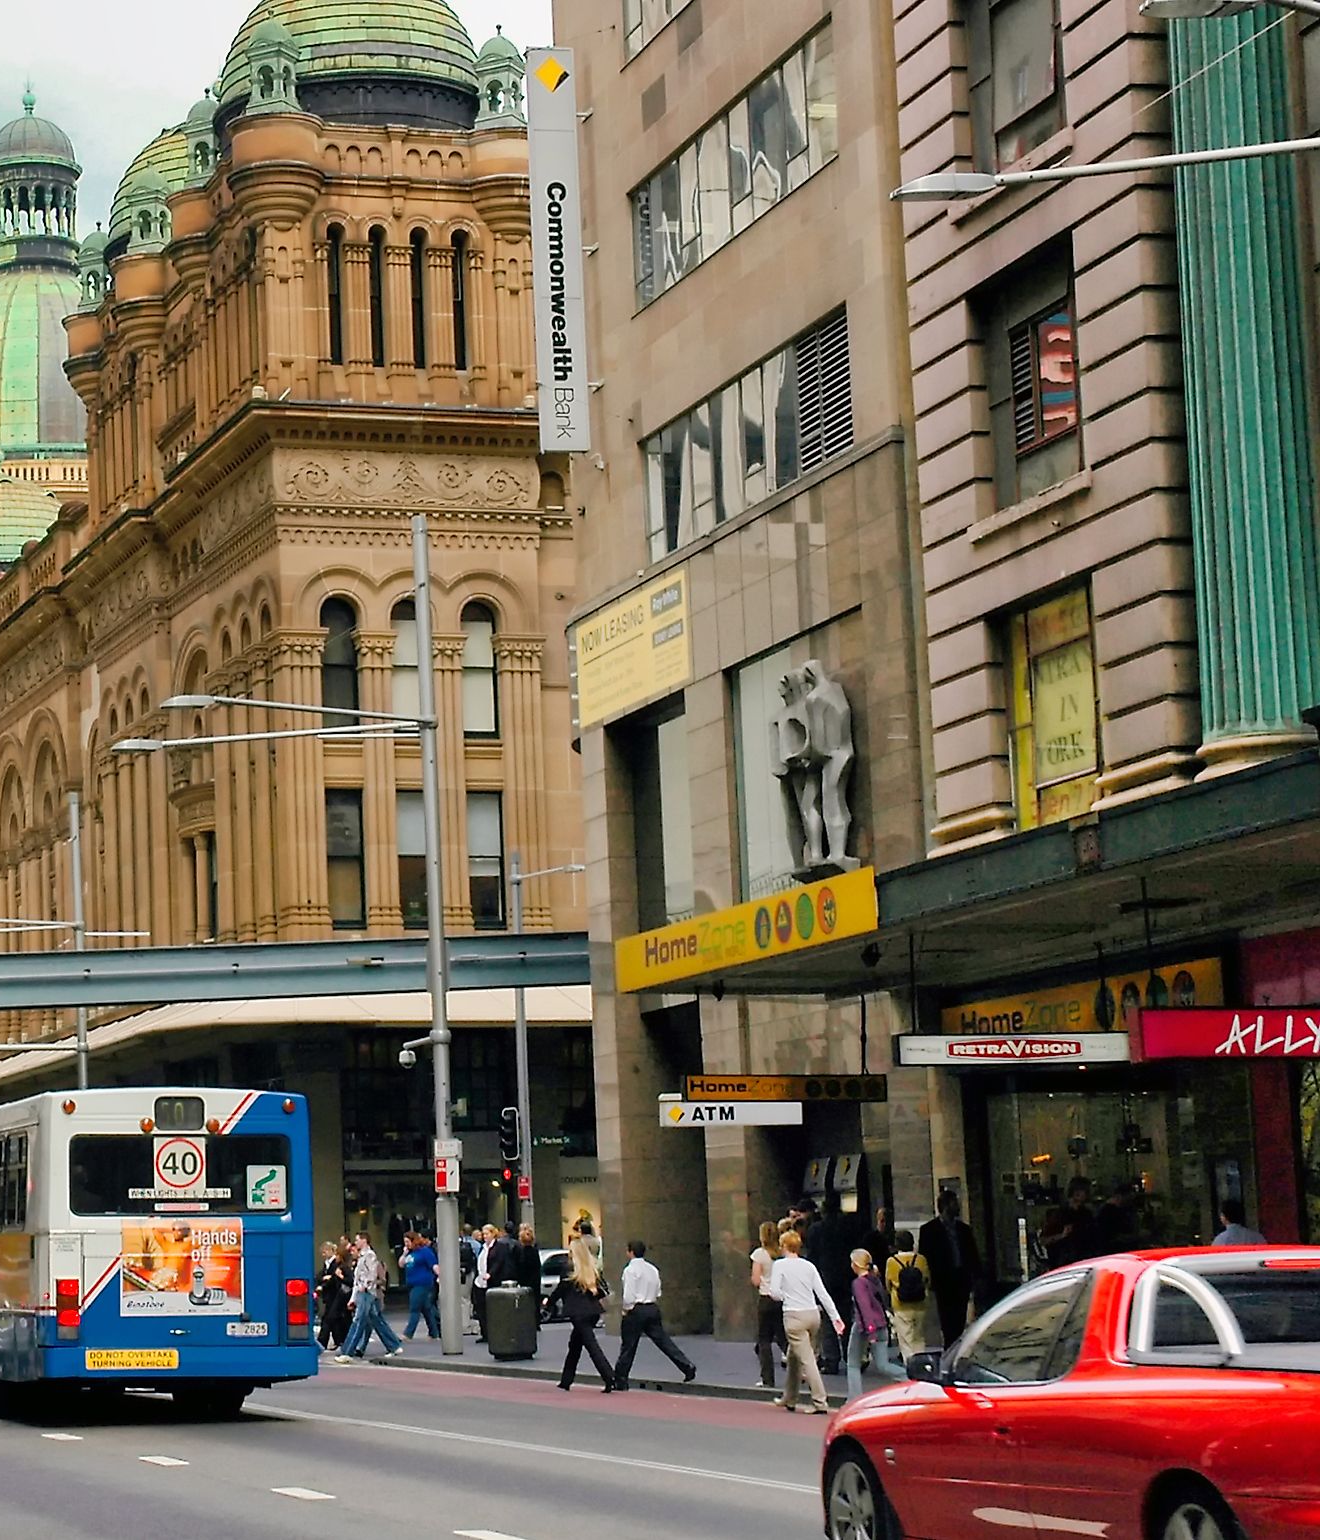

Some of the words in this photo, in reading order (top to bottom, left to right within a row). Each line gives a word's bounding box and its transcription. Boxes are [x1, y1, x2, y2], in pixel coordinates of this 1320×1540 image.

[547, 181, 574, 382] Commonwealth
[553, 386, 577, 440] Bank
[581, 626, 602, 655] NOW
[603, 604, 645, 643] LEASING
[952, 1039, 1077, 1058] RETRAVISION
[691, 1106, 736, 1121] ATM
[161, 1151, 198, 1176] 40
[183, 1189, 229, 1198] FLASH
[191, 1229, 237, 1246] Hands
[191, 1245, 212, 1262] off
[244, 1324, 267, 1335] 2825
[89, 1351, 104, 1360] DO
[106, 1351, 125, 1360] NOT
[127, 1351, 174, 1359] OVERTAKE
[92, 1360, 132, 1368] TURNING
[135, 1359, 173, 1367] VEHICLE
